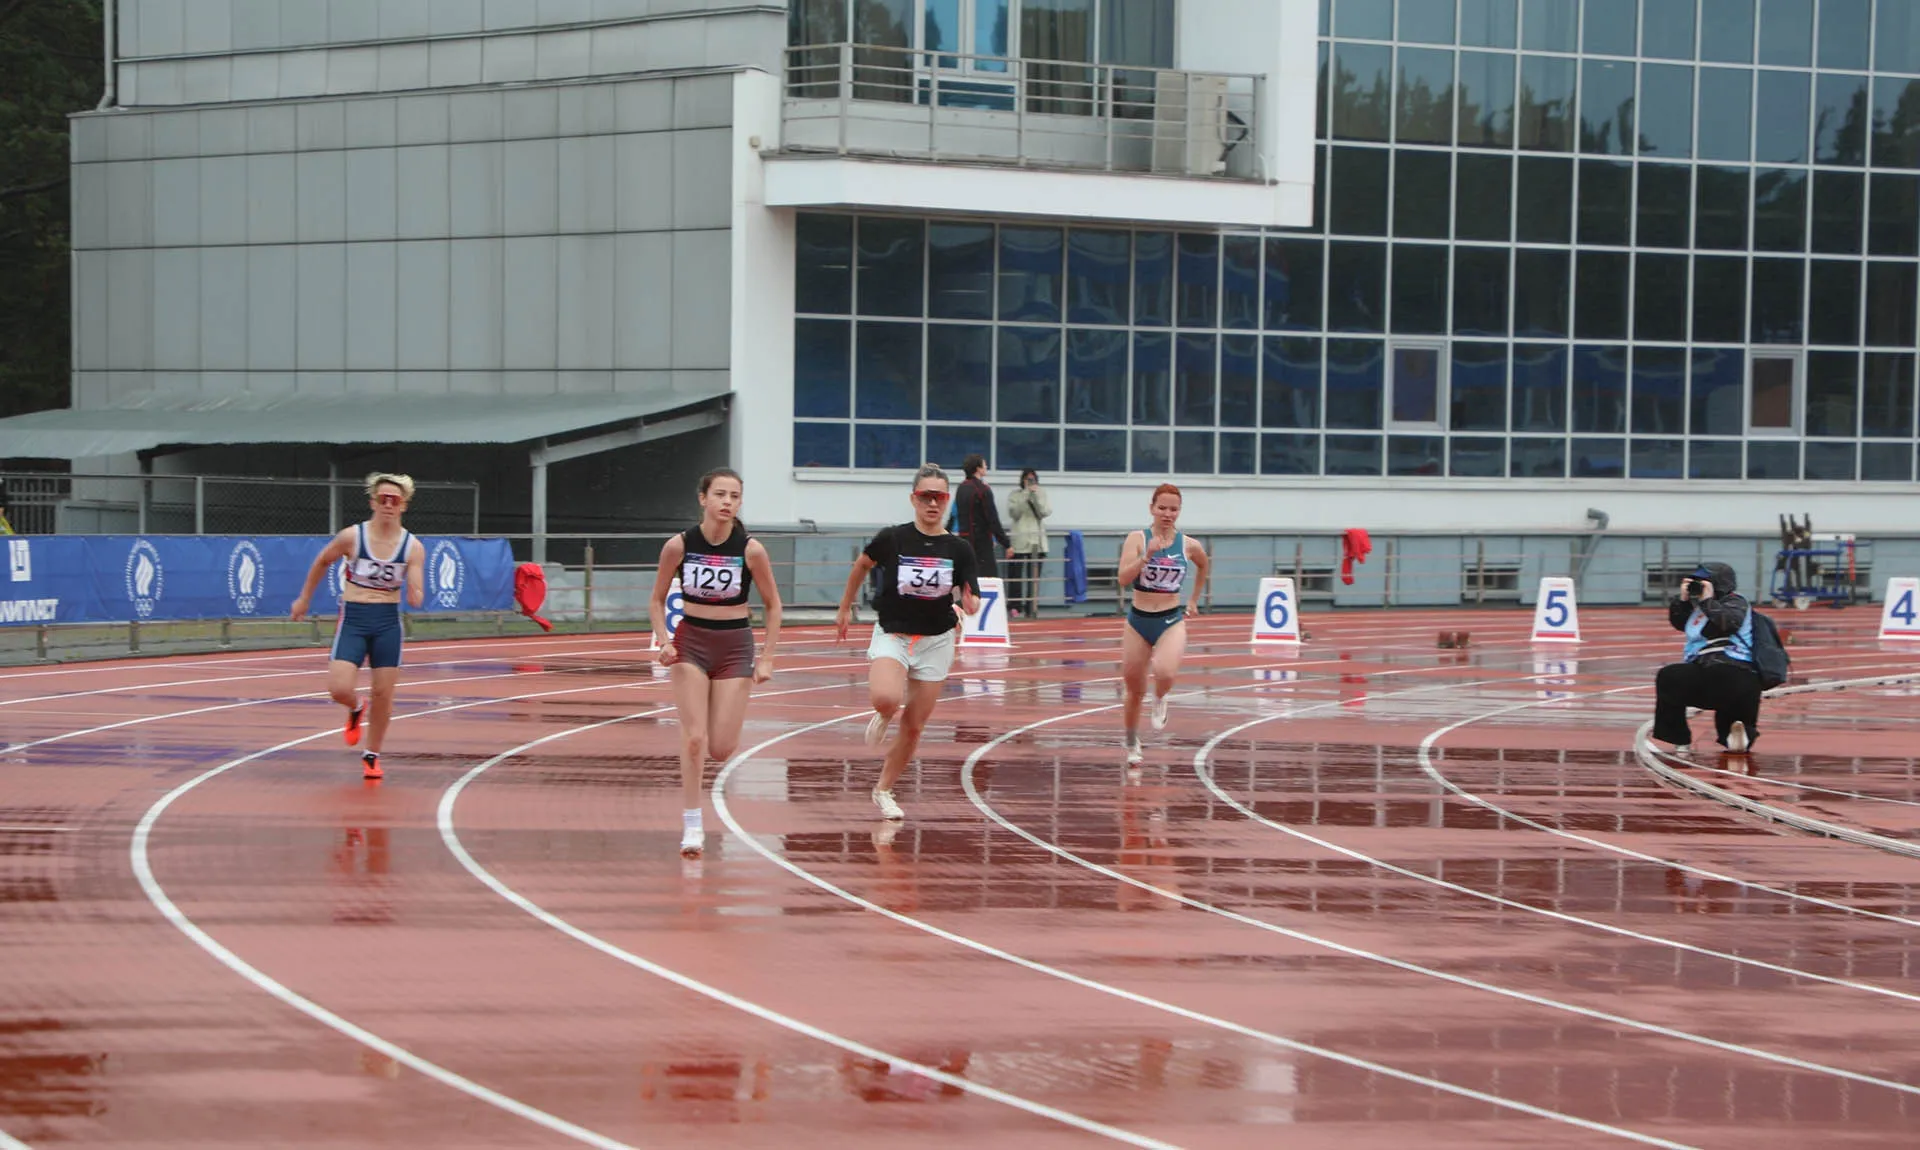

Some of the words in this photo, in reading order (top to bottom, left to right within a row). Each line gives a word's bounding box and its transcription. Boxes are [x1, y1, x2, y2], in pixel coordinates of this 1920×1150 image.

[692, 566, 733, 592] 129
[910, 568, 940, 589] 34
[1145, 566, 1181, 583] 377
[666, 592, 685, 634] 8
[978, 591, 999, 632] 7
[1264, 590, 1289, 629] 6
[1544, 590, 1568, 628] 5
[1890, 589, 1917, 626] 4
